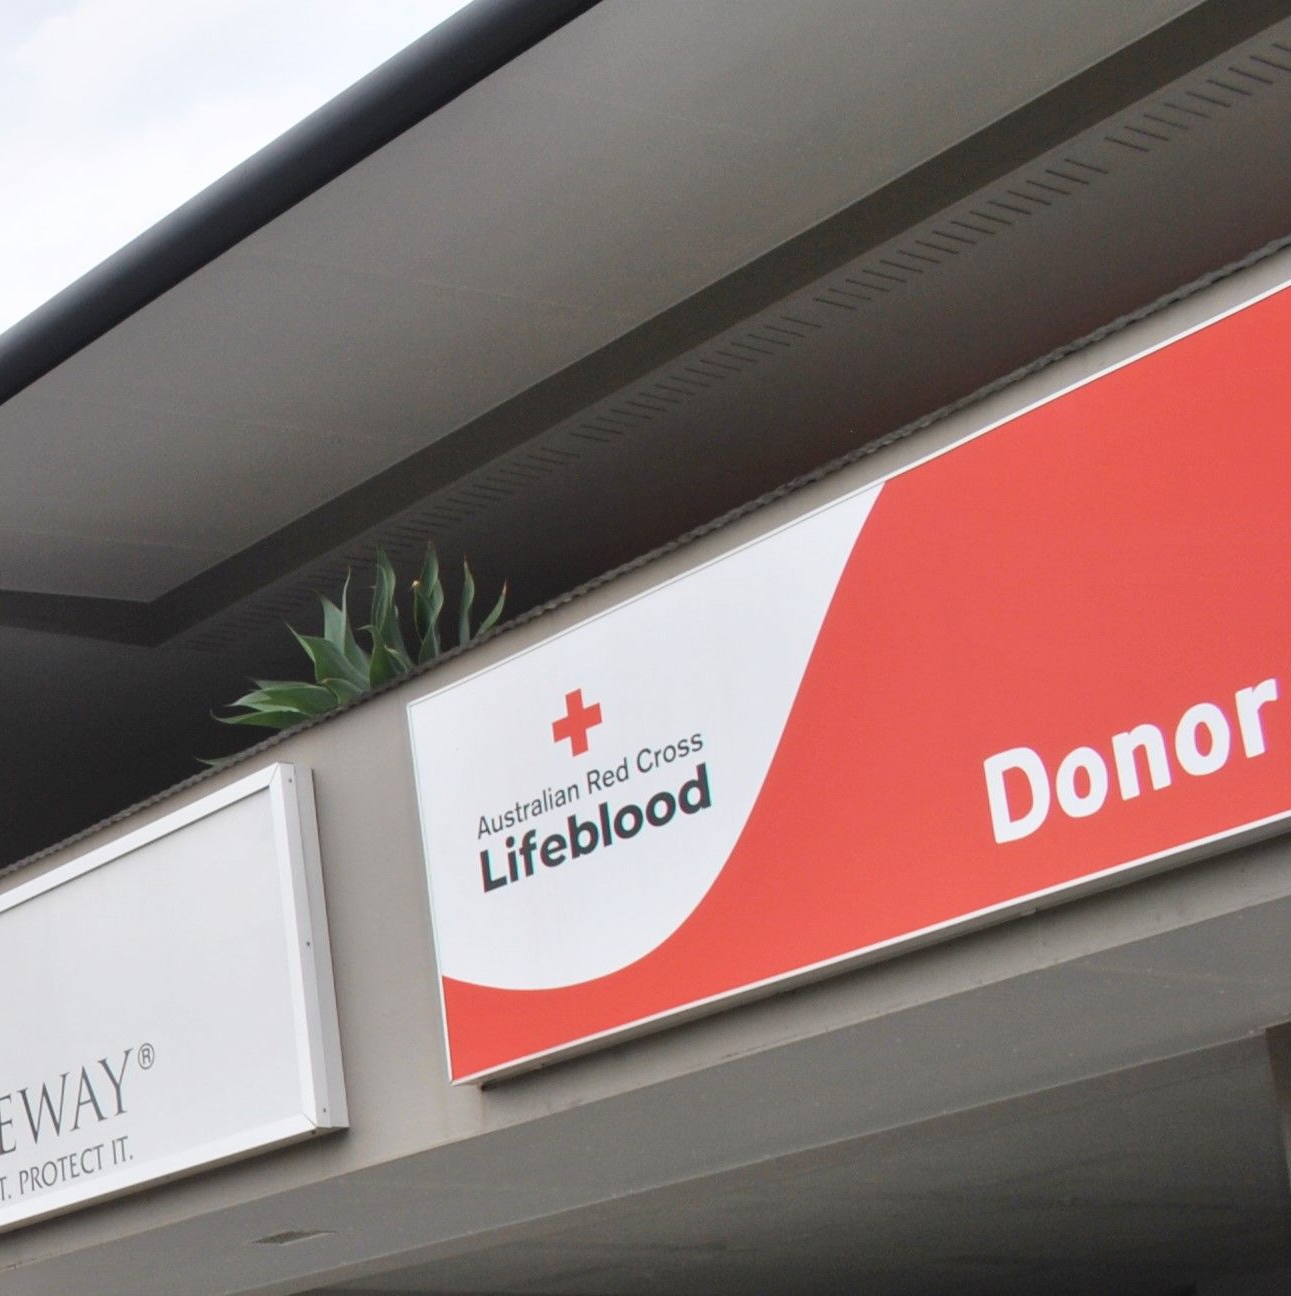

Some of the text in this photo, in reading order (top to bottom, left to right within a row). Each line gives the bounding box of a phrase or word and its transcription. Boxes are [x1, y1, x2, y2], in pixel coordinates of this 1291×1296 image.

[476, 732, 705, 840] Australian Red Cross
[982, 678, 1279, 845] Donor
[478, 763, 713, 893] Lifeblood
[18, 1143, 105, 1194] PROTECT
[111, 1135, 134, 1165] IT.
